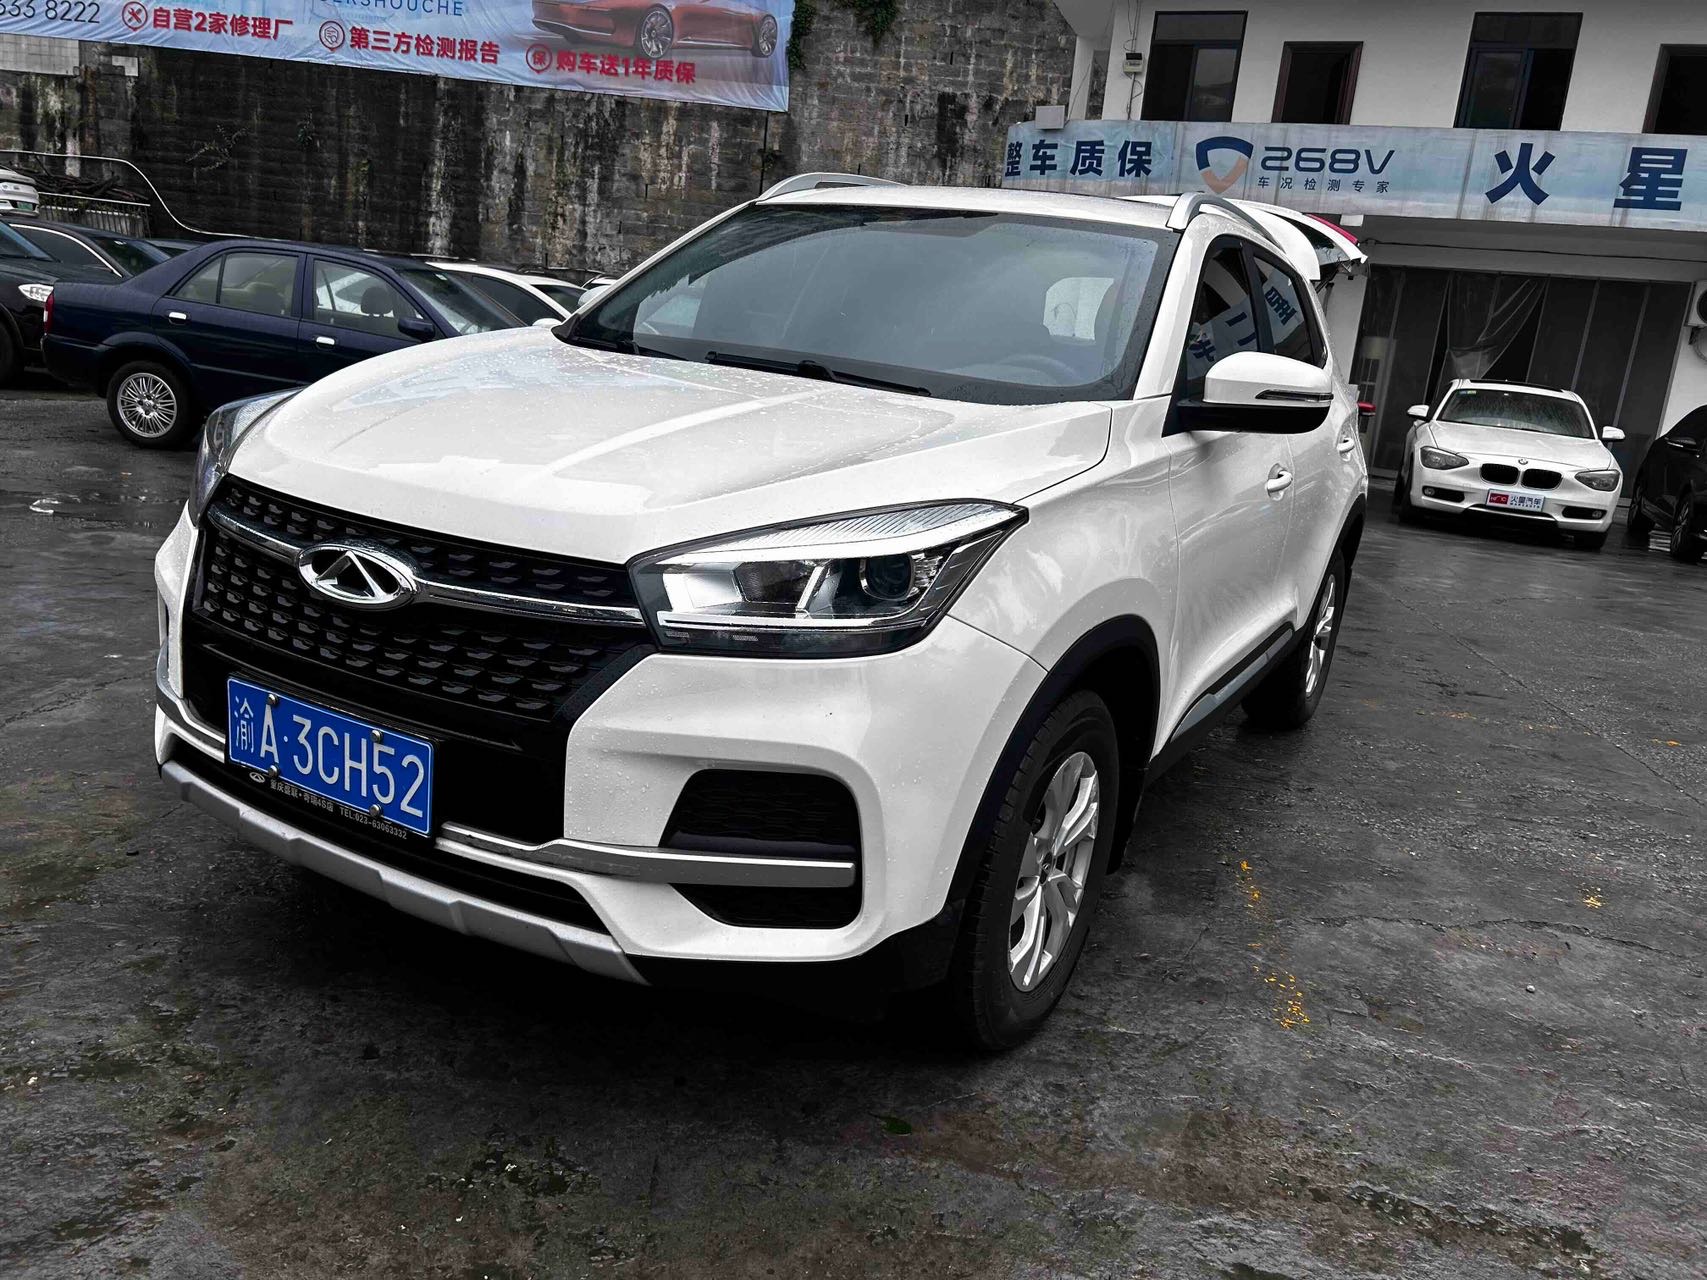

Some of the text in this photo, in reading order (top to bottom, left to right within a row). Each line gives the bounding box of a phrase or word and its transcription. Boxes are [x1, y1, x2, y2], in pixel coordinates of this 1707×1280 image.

[45, 0, 100, 24] 8222
[153, 6, 294, 40] 自营2家修理厂
[332, 0, 463, 16] HOUCHE
[349, 25, 501, 64] 第三方检测报告
[556, 49, 696, 84] 购车送1年质保
[1005, 138, 1153, 177] 整车质保
[1260, 145, 1396, 175] 268V
[1257, 175, 1390, 194] 车况检测专家
